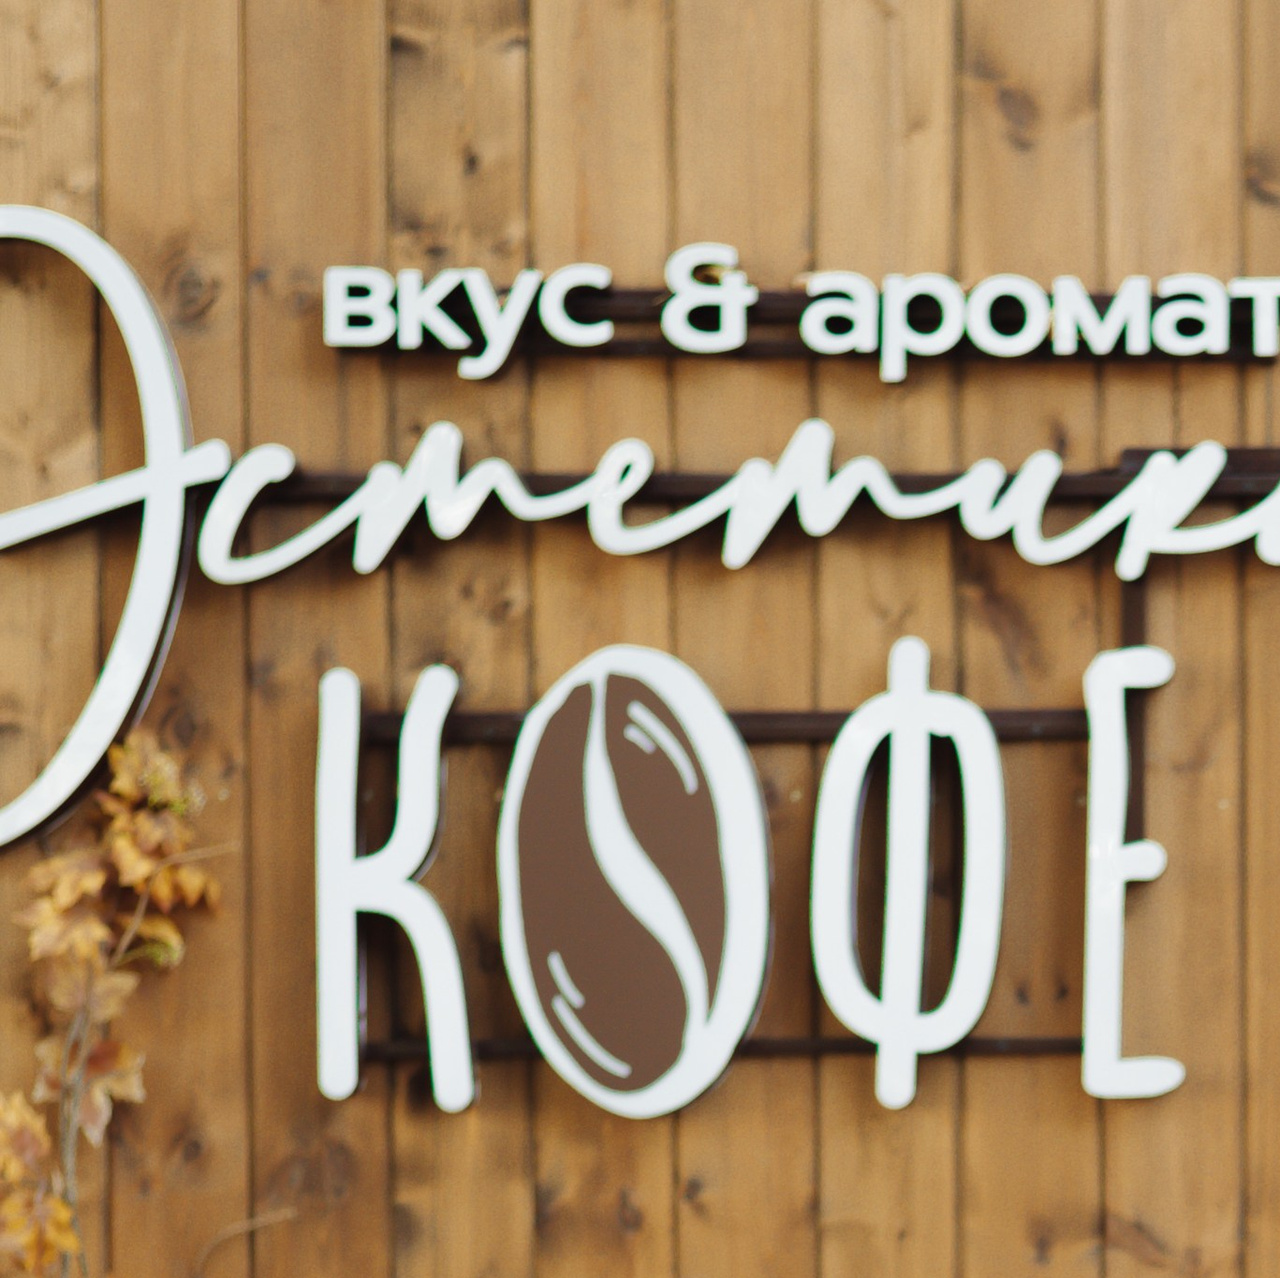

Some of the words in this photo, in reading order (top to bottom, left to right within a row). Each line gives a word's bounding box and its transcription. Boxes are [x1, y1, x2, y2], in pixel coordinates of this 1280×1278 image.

[321, 262, 615, 380] вкус
[660, 241, 757, 354] &
[315, 635, 1187, 1120] КОФЕ
